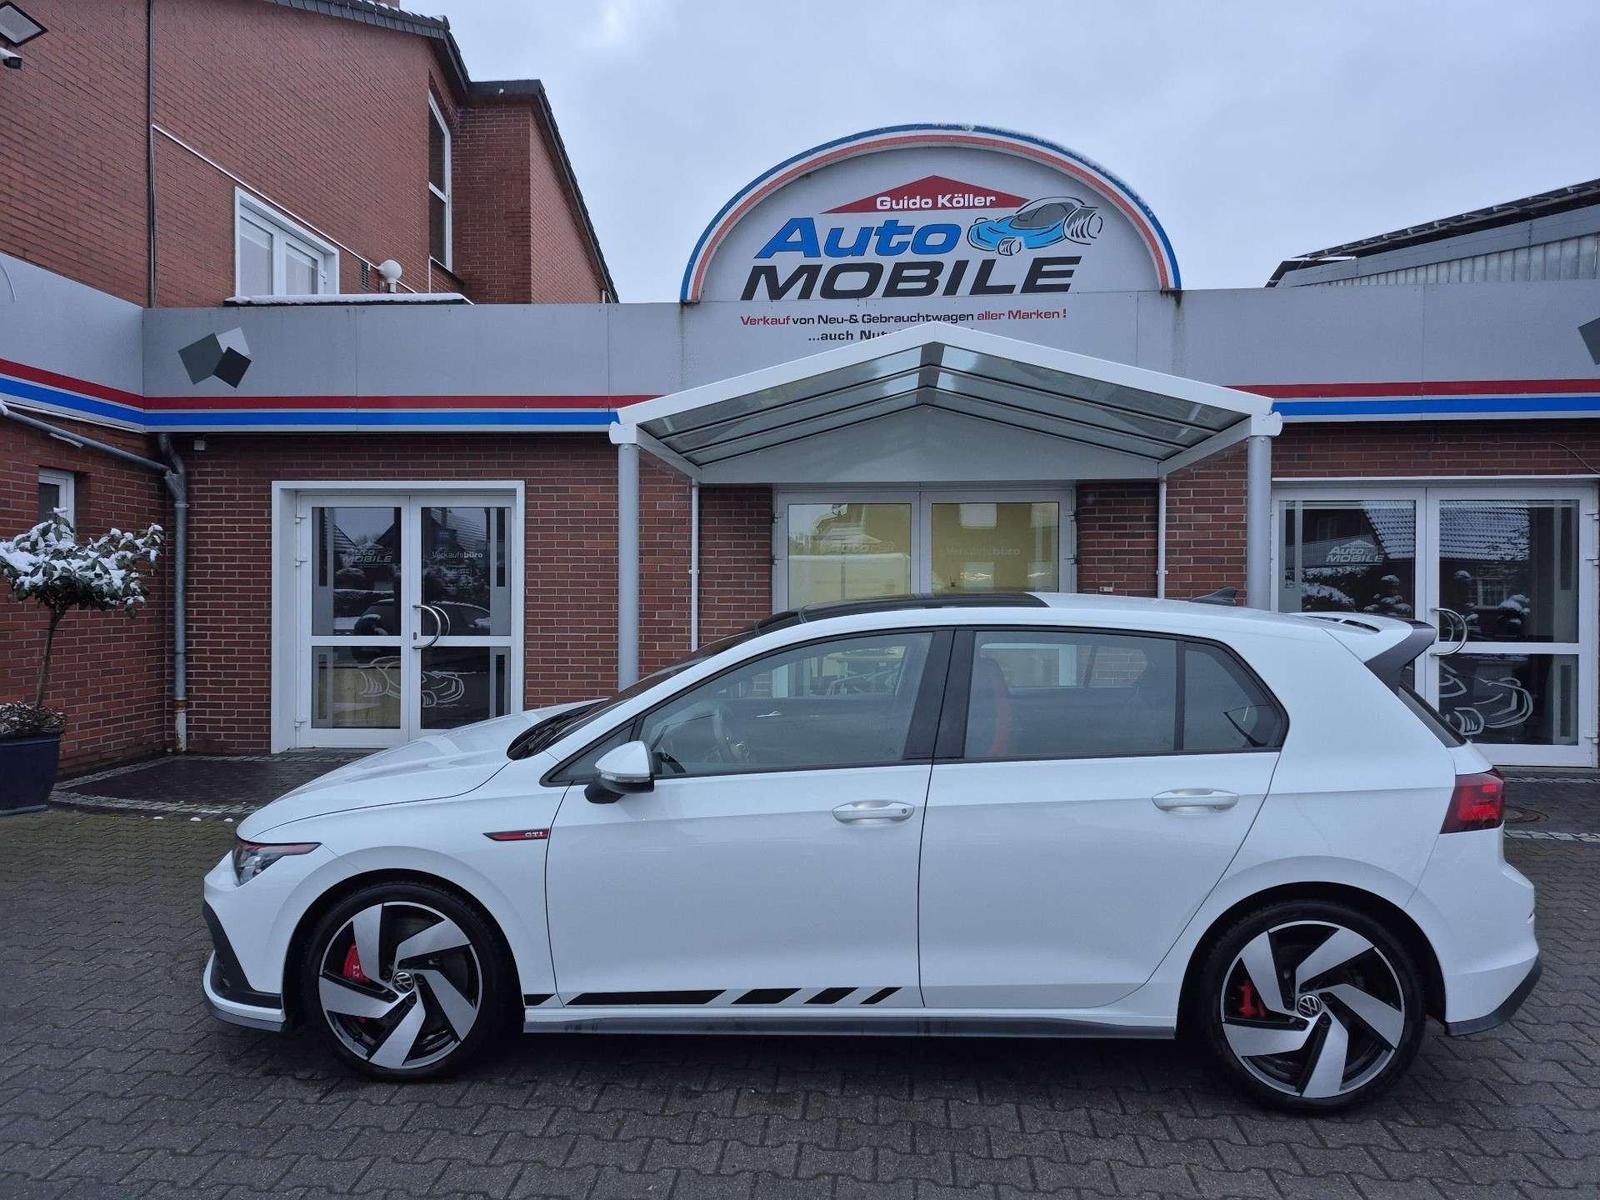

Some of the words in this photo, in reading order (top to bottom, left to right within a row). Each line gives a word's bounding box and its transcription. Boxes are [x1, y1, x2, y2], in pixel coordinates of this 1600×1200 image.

[876, 195, 932, 210] Guido
[937, 193, 996, 208] Köller
[753, 217, 961, 259] Auto
[739, 256, 1082, 301] MOBILE
[740, 315, 791, 326] Verkauf
[792, 316, 815, 325] von
[861, 312, 974, 324] Gebrauchtwagen
[977, 309, 1005, 321] aller
[808, 329, 854, 341] ...auch
